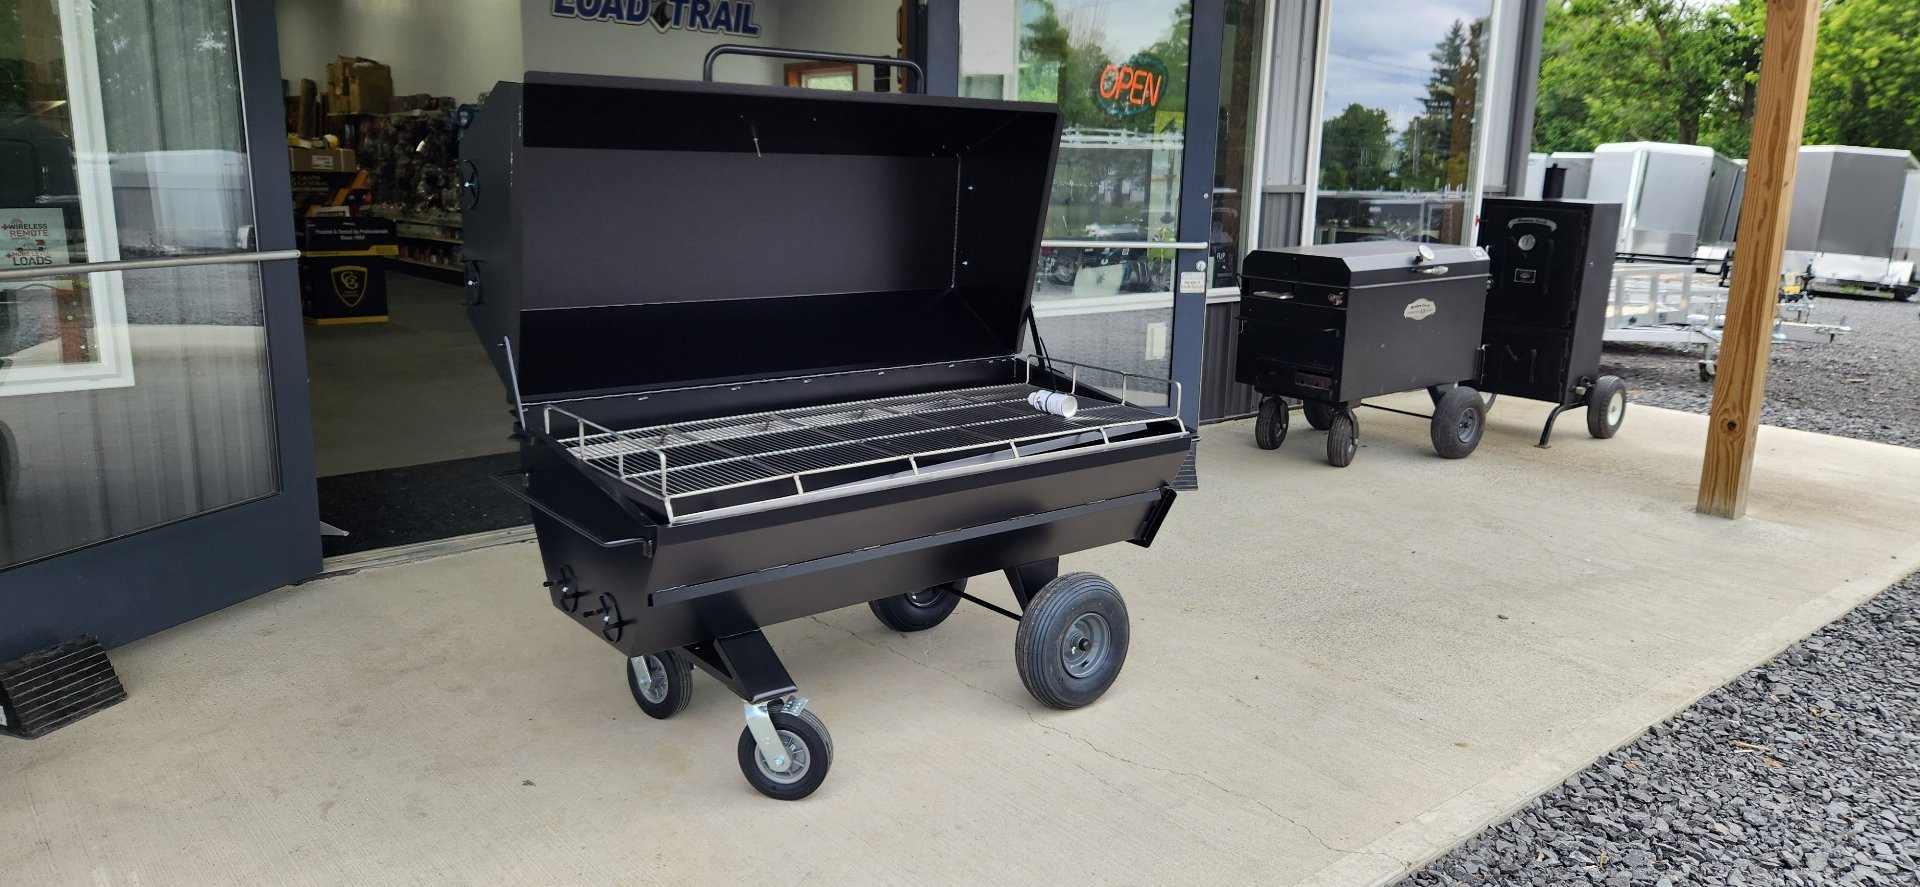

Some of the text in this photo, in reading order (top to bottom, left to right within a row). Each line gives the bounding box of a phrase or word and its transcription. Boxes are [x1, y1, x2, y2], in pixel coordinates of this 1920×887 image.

[671, 0, 760, 37] TRAIL
[1100, 64, 1162, 107] OPEN
[13, 256, 52, 266] LOADS
